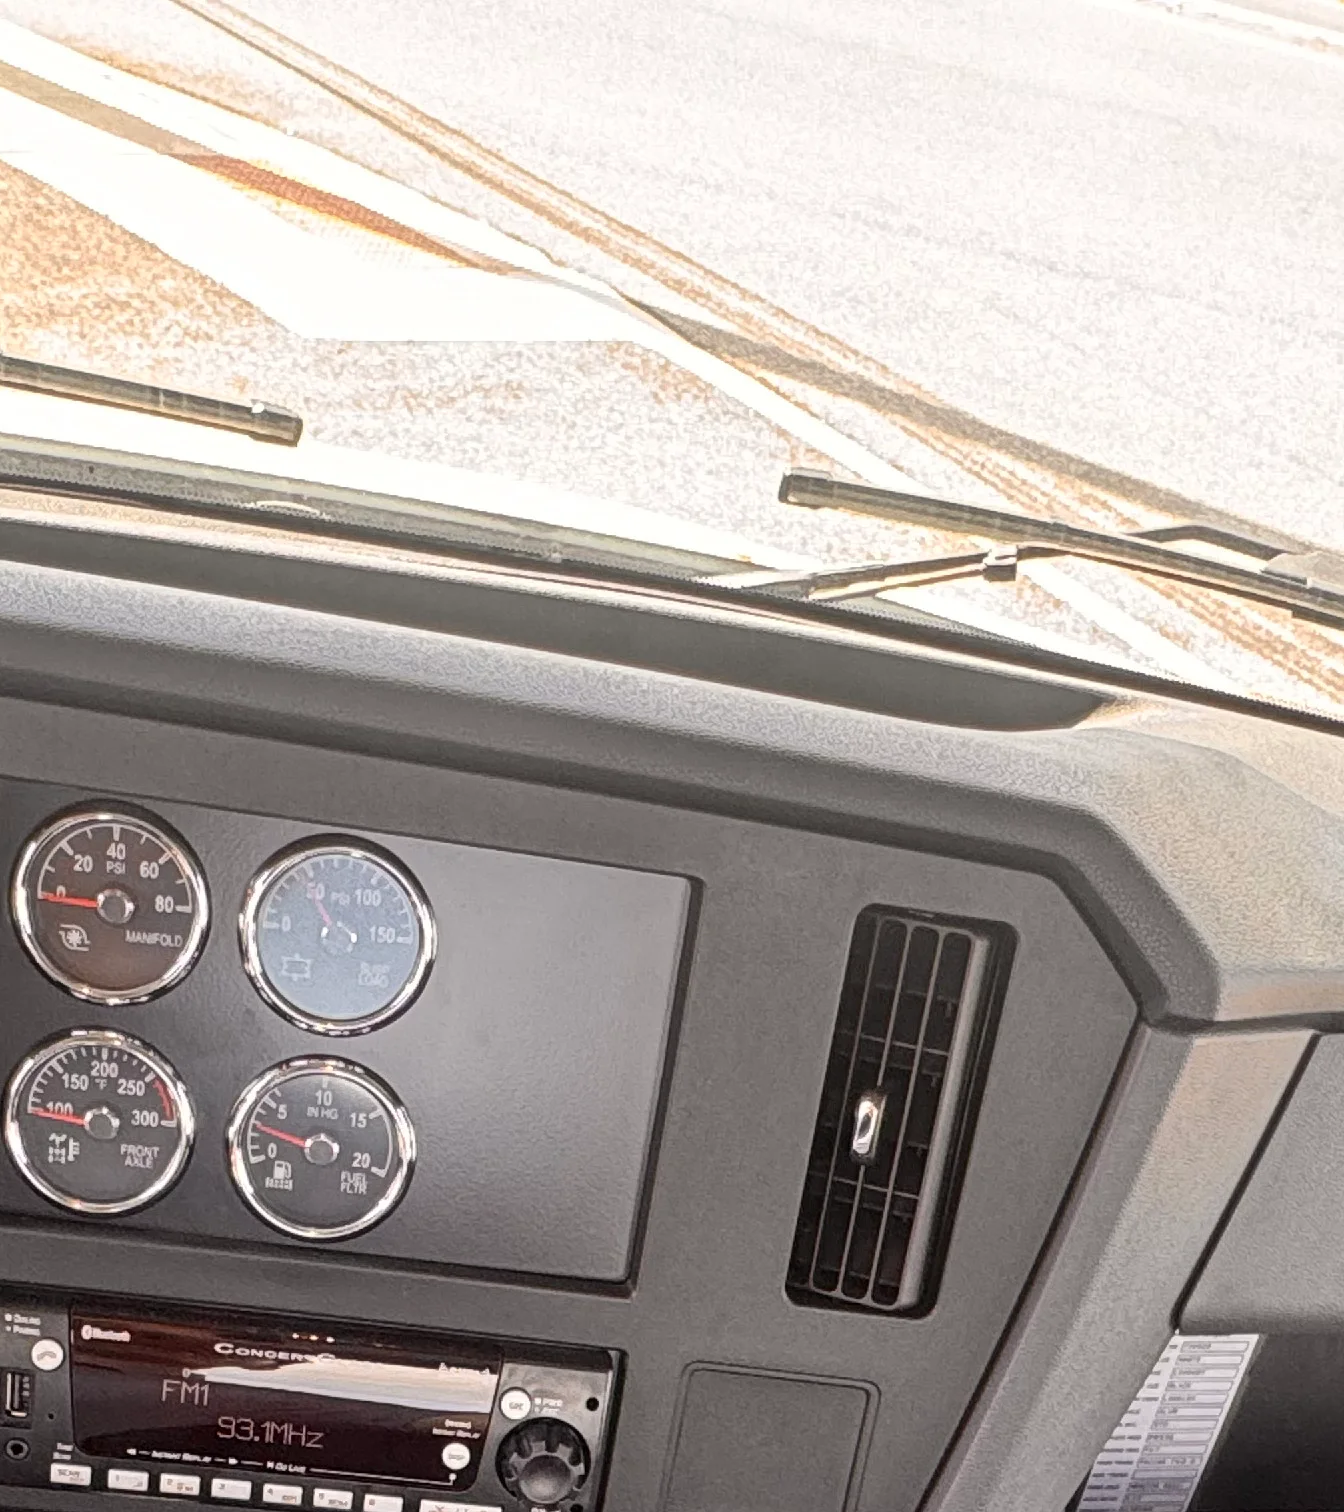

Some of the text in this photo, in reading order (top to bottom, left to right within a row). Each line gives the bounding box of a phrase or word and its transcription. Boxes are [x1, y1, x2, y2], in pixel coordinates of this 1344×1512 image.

[106, 843, 126, 860] 40
[73, 855, 93, 873] 20
[106, 862, 126, 875] PSI
[139, 862, 159, 879] 60
[155, 895, 174, 913] 80
[355, 888, 382, 907] 100
[281, 915, 291, 932] 0
[125, 930, 183, 948] MANIFOLD
[369, 926, 396, 944] 150
[90, 1061, 119, 1078] 200
[62, 1072, 90, 1091] 150
[117, 1079, 145, 1097] 250
[315, 1090, 332, 1106] 10
[46, 1102, 74, 1117] 100
[277, 1104, 288, 1120] 5
[130, 1110, 159, 1127] 300
[349, 1112, 367, 1129] 15
[120, 1143, 160, 1158] FRONT
[267, 1142, 277, 1159] 0
[124, 1156, 153, 1169] AXLE
[351, 1152, 371, 1169] 20
[161, 1378, 210, 1406] FM1
[217, 1416, 323, 1447] 93.1MHz
